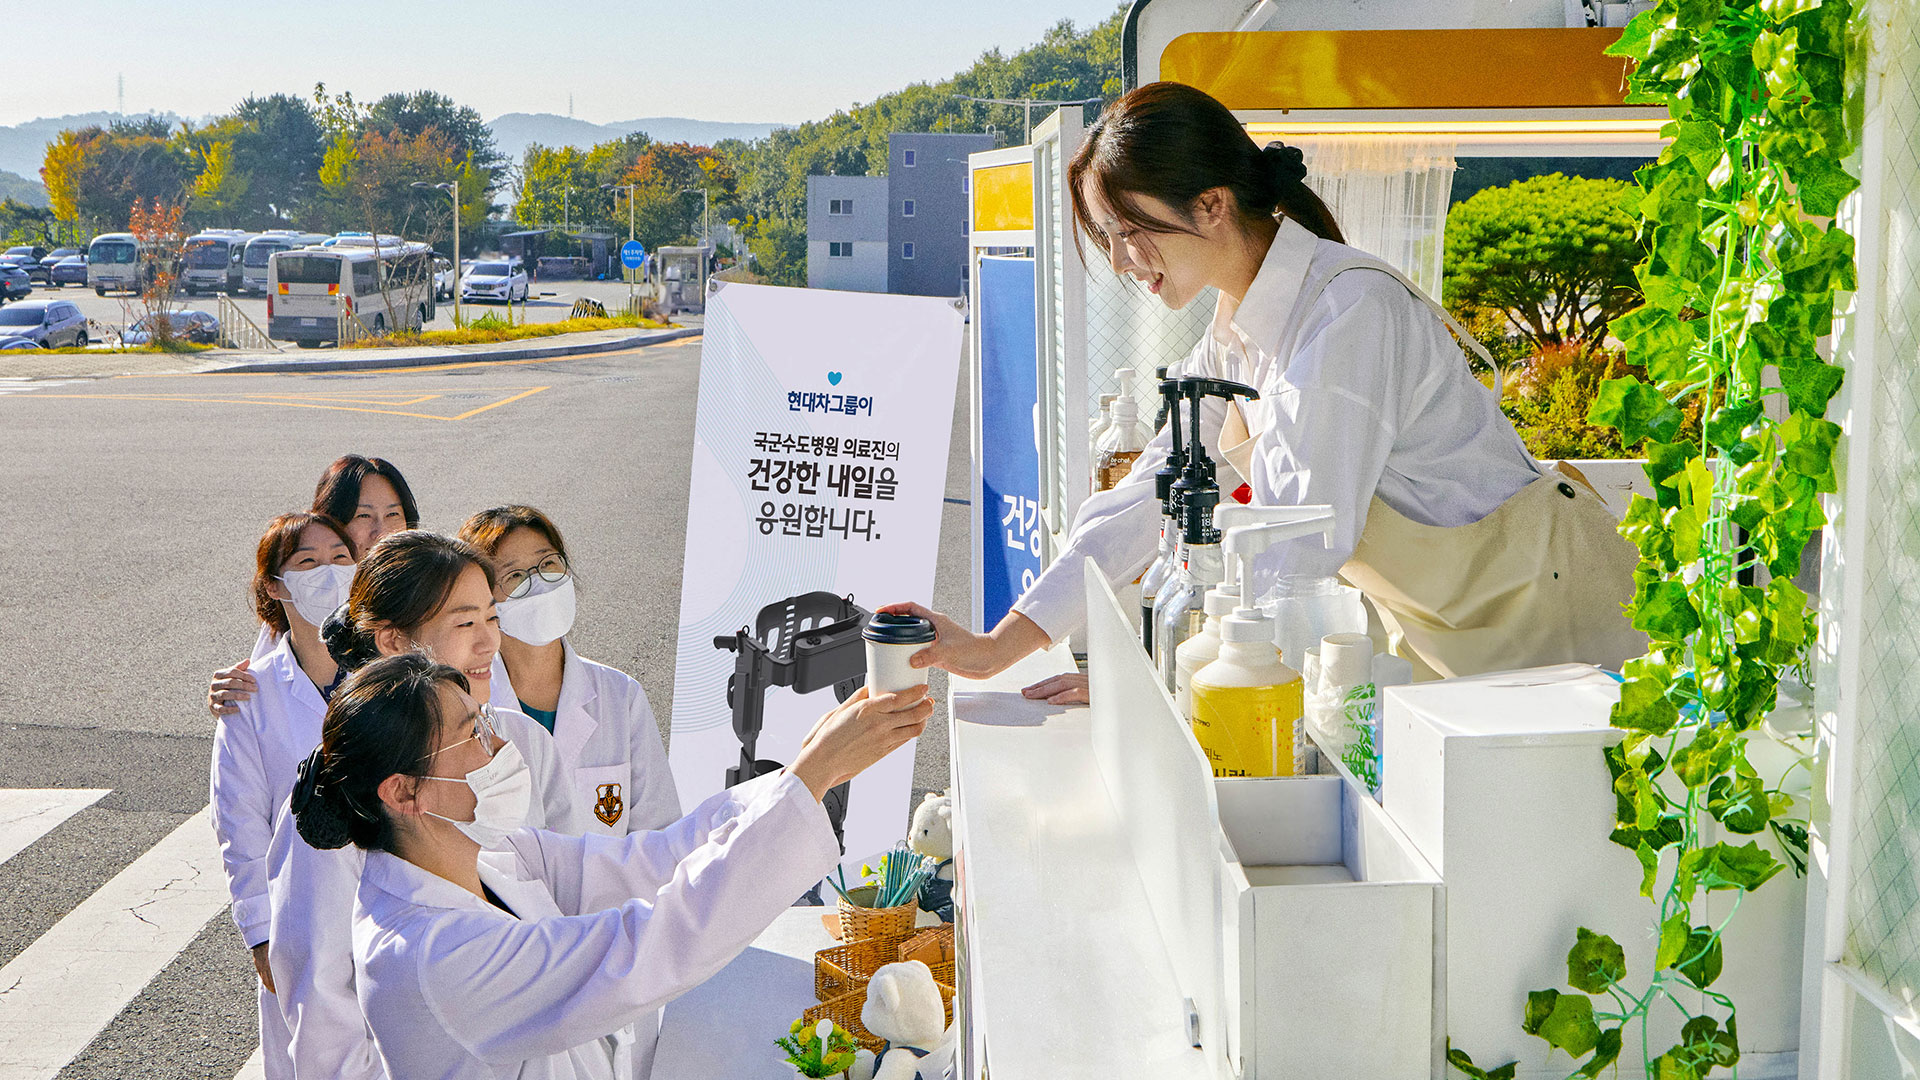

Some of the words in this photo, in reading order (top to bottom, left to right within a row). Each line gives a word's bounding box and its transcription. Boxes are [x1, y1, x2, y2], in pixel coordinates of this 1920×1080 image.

[787, 390, 873, 417] 현대차그룹이
[754, 432, 839, 457] 국군수도병원
[843, 438, 900, 461] 의료진의
[748, 459, 820, 495] 건강한
[827, 465, 899, 500] 내일을
[756, 502, 881, 541] 응원합니다.
